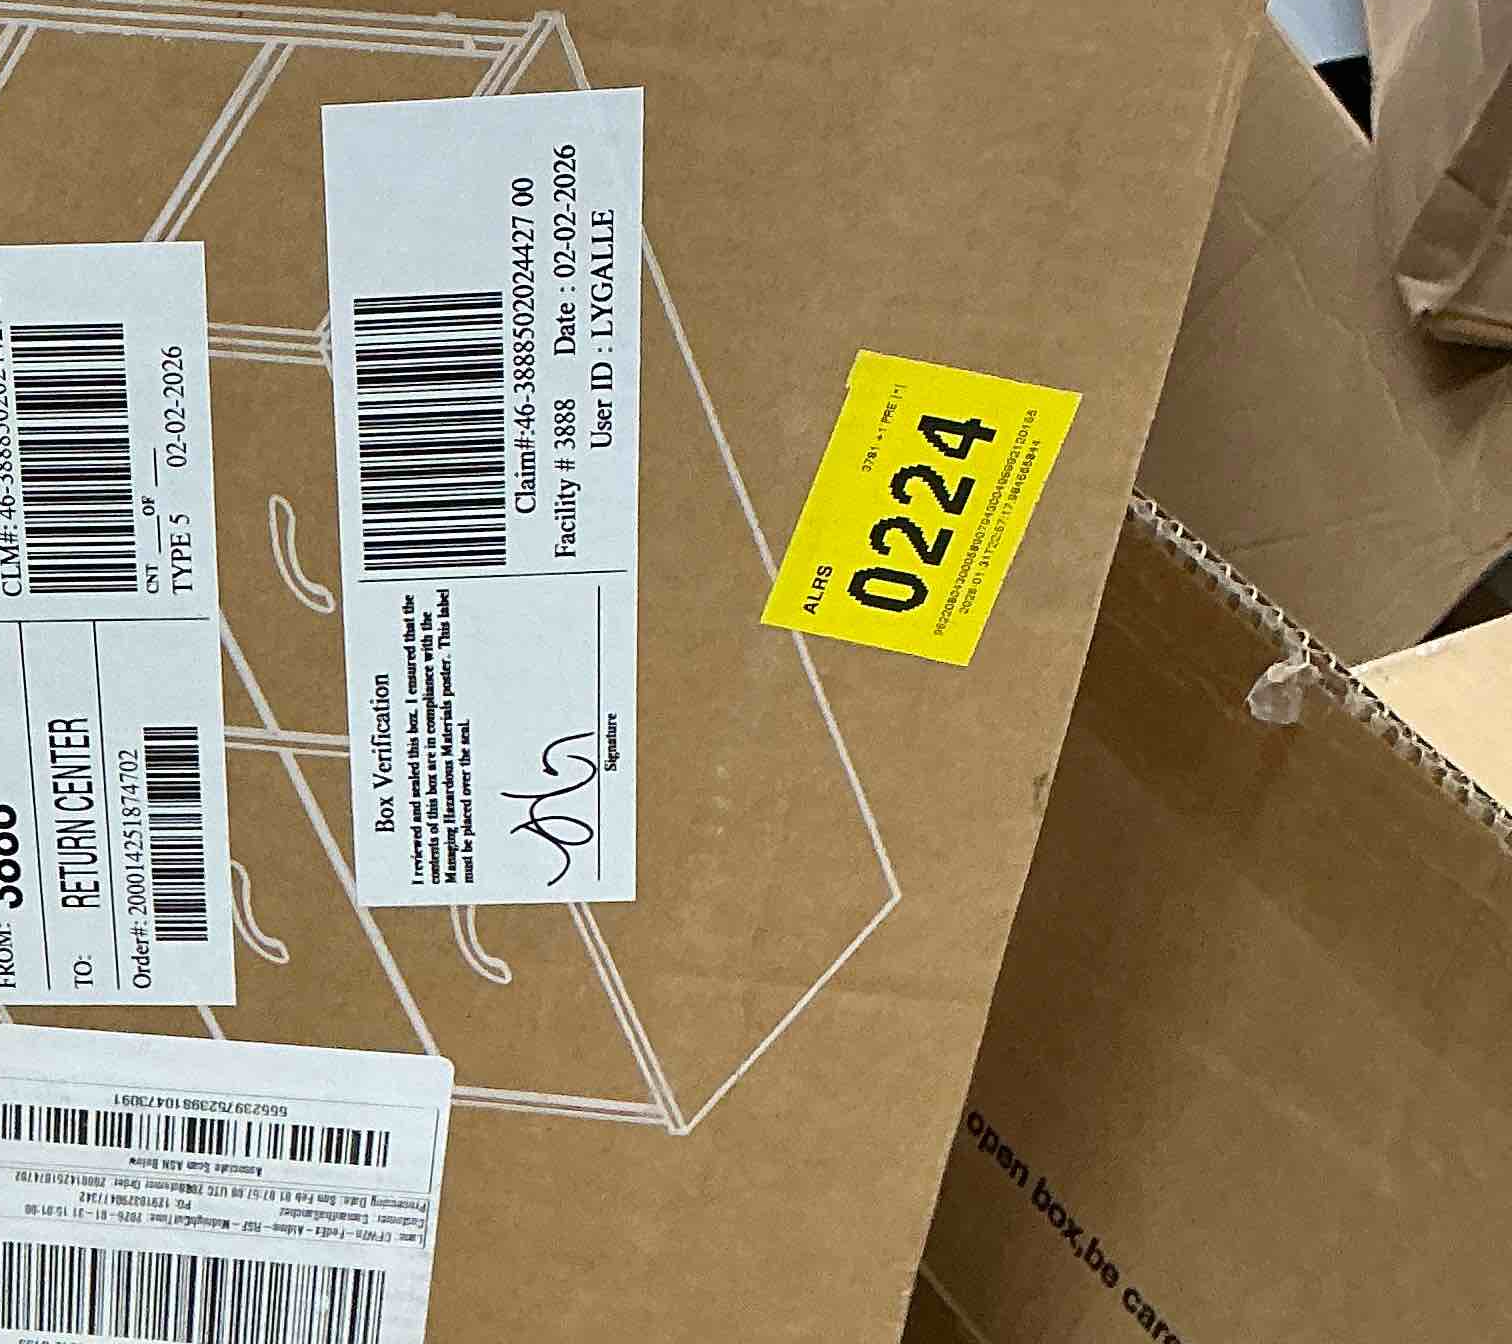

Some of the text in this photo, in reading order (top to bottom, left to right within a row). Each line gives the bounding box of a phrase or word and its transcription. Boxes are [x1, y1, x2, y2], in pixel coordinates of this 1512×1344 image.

[553, 144, 576, 278] 02-02-2026
[590, 209, 614, 338] LYGALLE
[512, 178, 536, 514] Claim#:46-3888502024427 00
[554, 303, 576, 356] Date
[591, 362, 613, 390] ID
[554, 399, 576, 449] 3888
[590, 399, 612, 449] User
[161, 346, 193, 594] TYPE 5 02-02-2026
[554, 458, 575, 472] #
[554, 478, 581, 558] Facility
[847, 415, 997, 613] 0224
[142, 496, 159, 594] CNT OF
[401, 593, 415, 614] the
[436, 588, 450, 618] label
[803, 566, 833, 615] ALRS
[402, 616, 416, 643] that
[436, 620, 451, 649] This
[404, 644, 418, 695] ensured
[369, 672, 395, 833] Box Verification
[406, 735, 420, 758] this
[419, 610, 441, 885] contents of this box are in compliance with the
[439, 699, 455, 756] Materials
[602, 712, 619, 771] Signature
[406, 760, 421, 797] sealed
[458, 747, 471, 766] the
[441, 758, 456, 824] Hazardous
[459, 768, 472, 796] over
[409, 800, 422, 822] and
[459, 798, 475, 837] placed
[48, 718, 100, 989] TO: RETURN CENTER
[118, 749, 152, 989] Order#: 200014251874702
[409, 824, 424, 877] reviewed
[443, 825, 460, 883] Managing
[460, 838, 473, 852] be
[461, 854, 475, 884] must
[212, 1160, 263, 1177] Associate
[961, 1111, 1029, 1188] open
[205, 1183, 227, 1196] UTC
[293, 1190, 313, 1204] Feb
[369, 1193, 426, 1212] Processing
